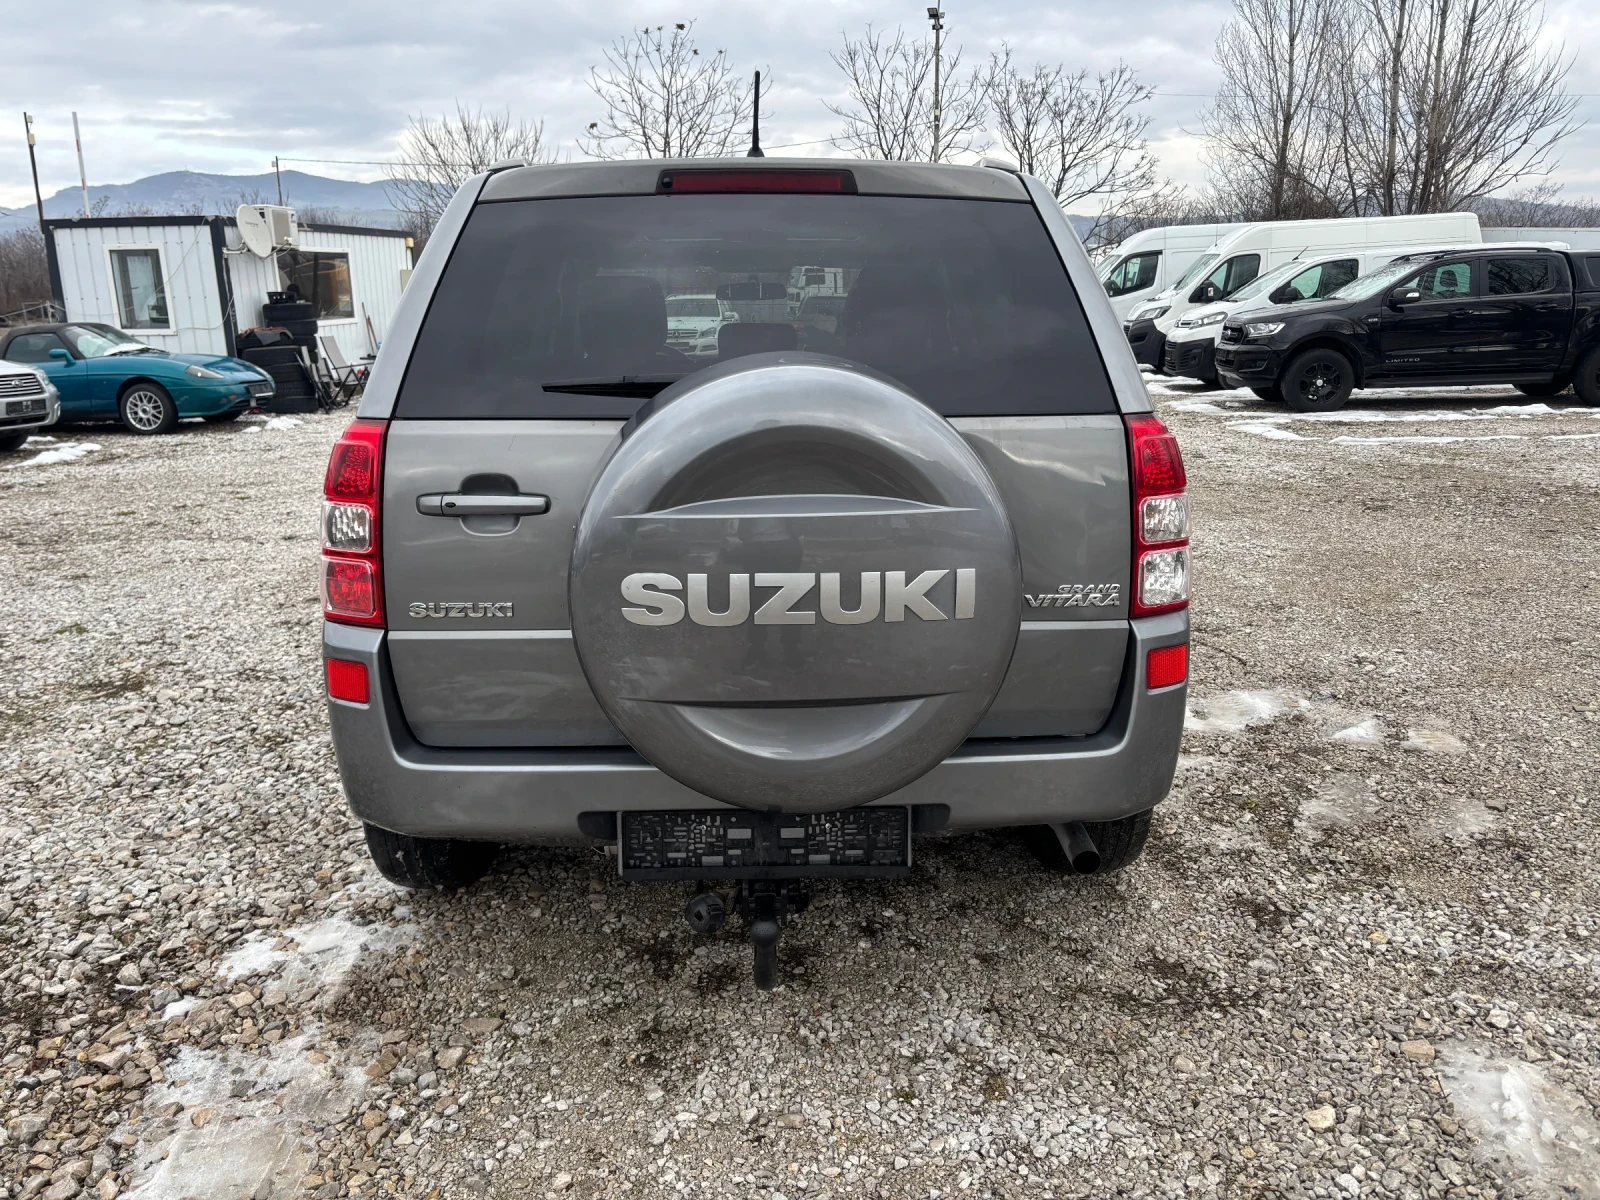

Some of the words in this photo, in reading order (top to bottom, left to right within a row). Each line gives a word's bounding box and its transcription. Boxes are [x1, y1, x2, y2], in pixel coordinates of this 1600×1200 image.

[1057, 583, 1121, 594] GRAND
[620, 568, 976, 627] SUZUKI
[1024, 593, 1121, 608] VITARA
[408, 602, 514, 618] SUZUKI
